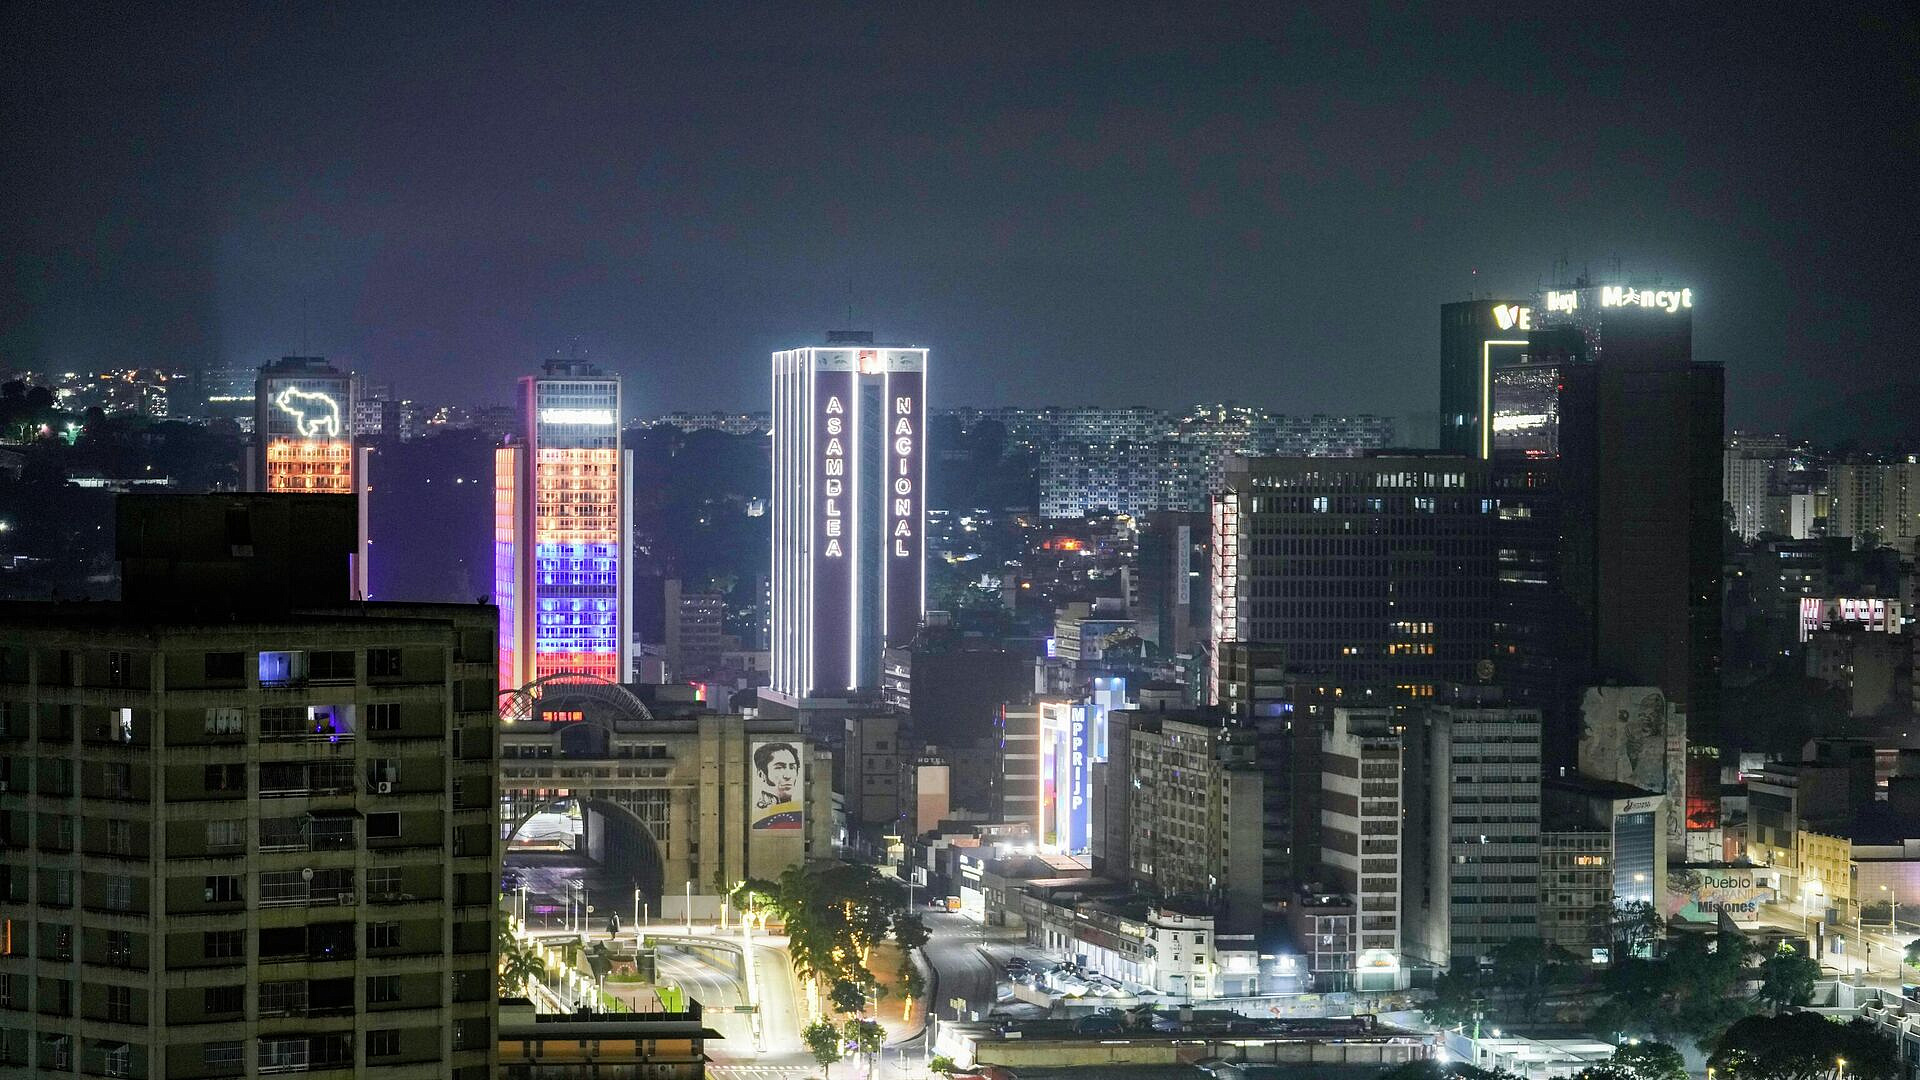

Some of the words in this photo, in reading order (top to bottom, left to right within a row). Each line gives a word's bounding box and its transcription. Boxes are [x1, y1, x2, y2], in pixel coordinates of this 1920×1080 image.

[825, 396, 843, 557] ASAMBLEA
[895, 397, 912, 557] NACIONAL
[1071, 708, 1085, 810] MPPRIJP
[1697, 901, 1756, 913] Misiones
[1704, 876, 1751, 889] Pueblo
